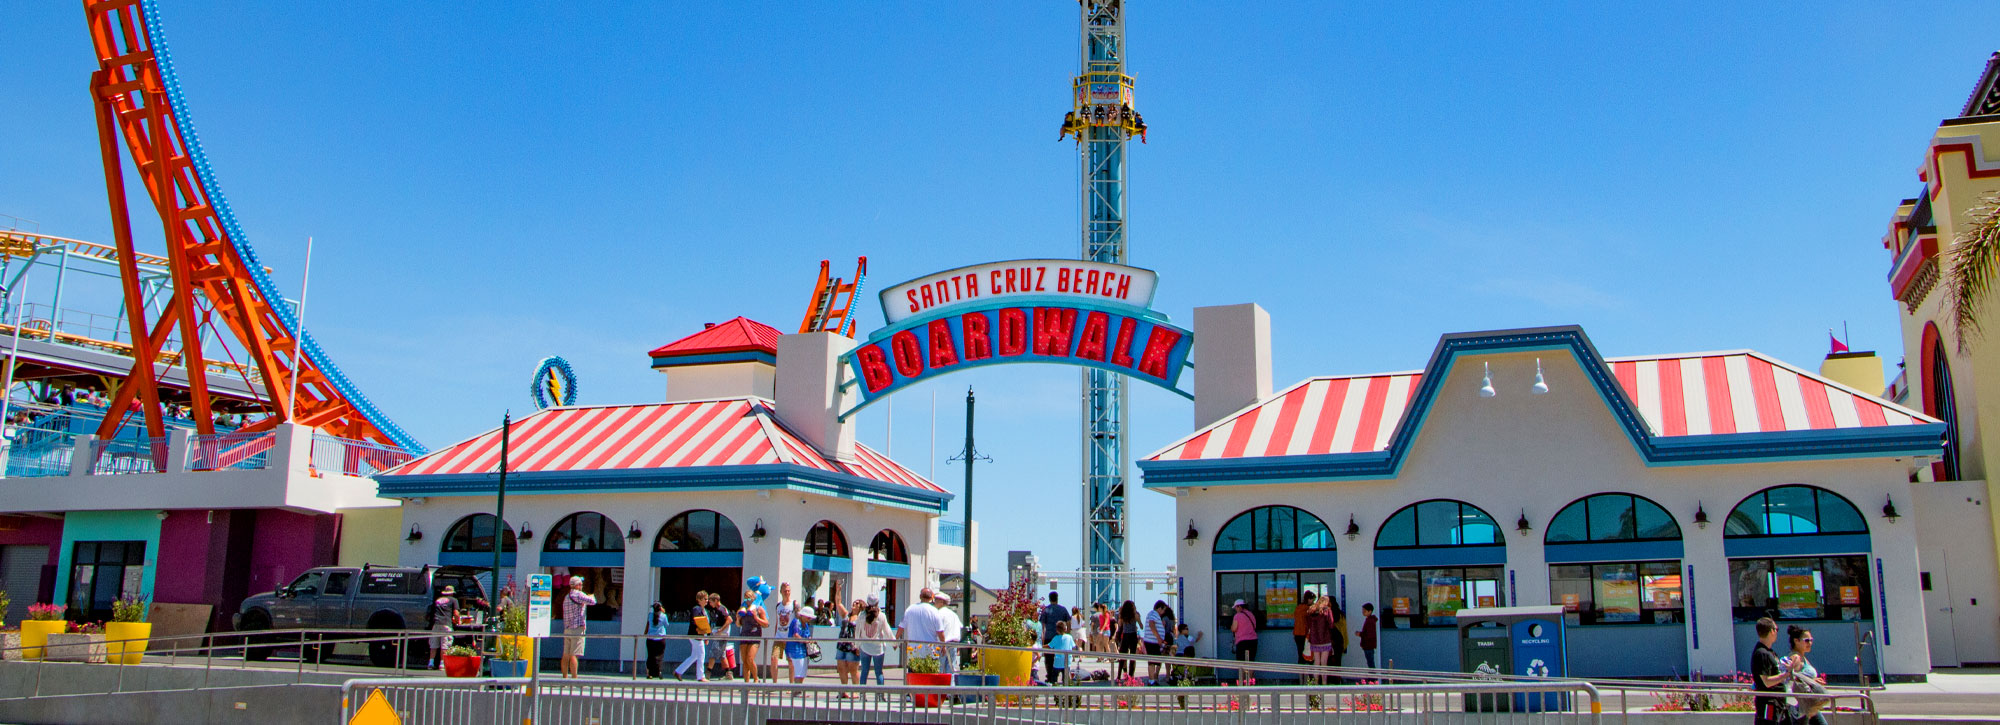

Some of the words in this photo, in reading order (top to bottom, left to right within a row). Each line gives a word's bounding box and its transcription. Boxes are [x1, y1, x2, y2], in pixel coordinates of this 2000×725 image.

[906, 273, 979, 313] SANTA
[990, 266, 1046, 295] CRUZ
[1057, 267, 1131, 300] BEACH
[856, 307, 1182, 393] BOARDWALK
